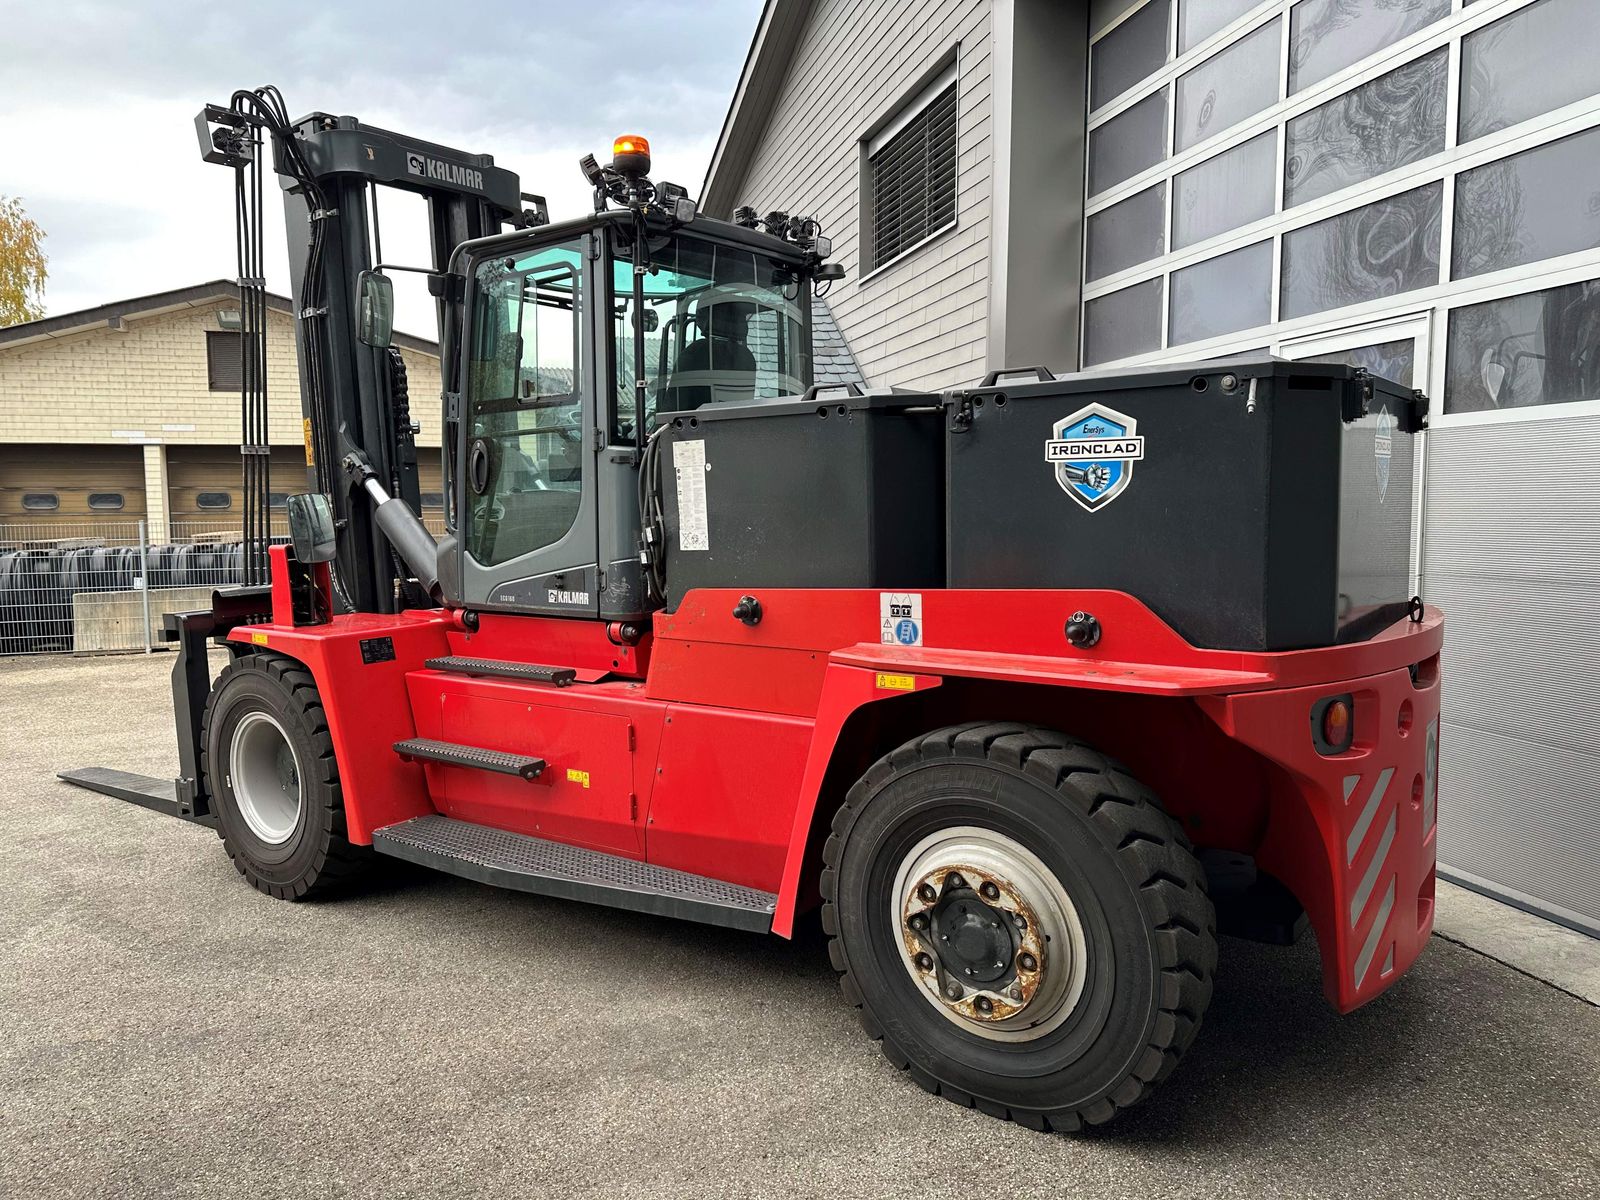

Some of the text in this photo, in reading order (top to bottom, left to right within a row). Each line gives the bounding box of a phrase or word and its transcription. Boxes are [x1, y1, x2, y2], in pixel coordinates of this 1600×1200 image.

[427, 158, 484, 190] KALMAR
[1083, 424, 1105, 435] EnerSys
[1051, 443, 1137, 456] IRONCLAD
[558, 590, 589, 605] KALMAR
